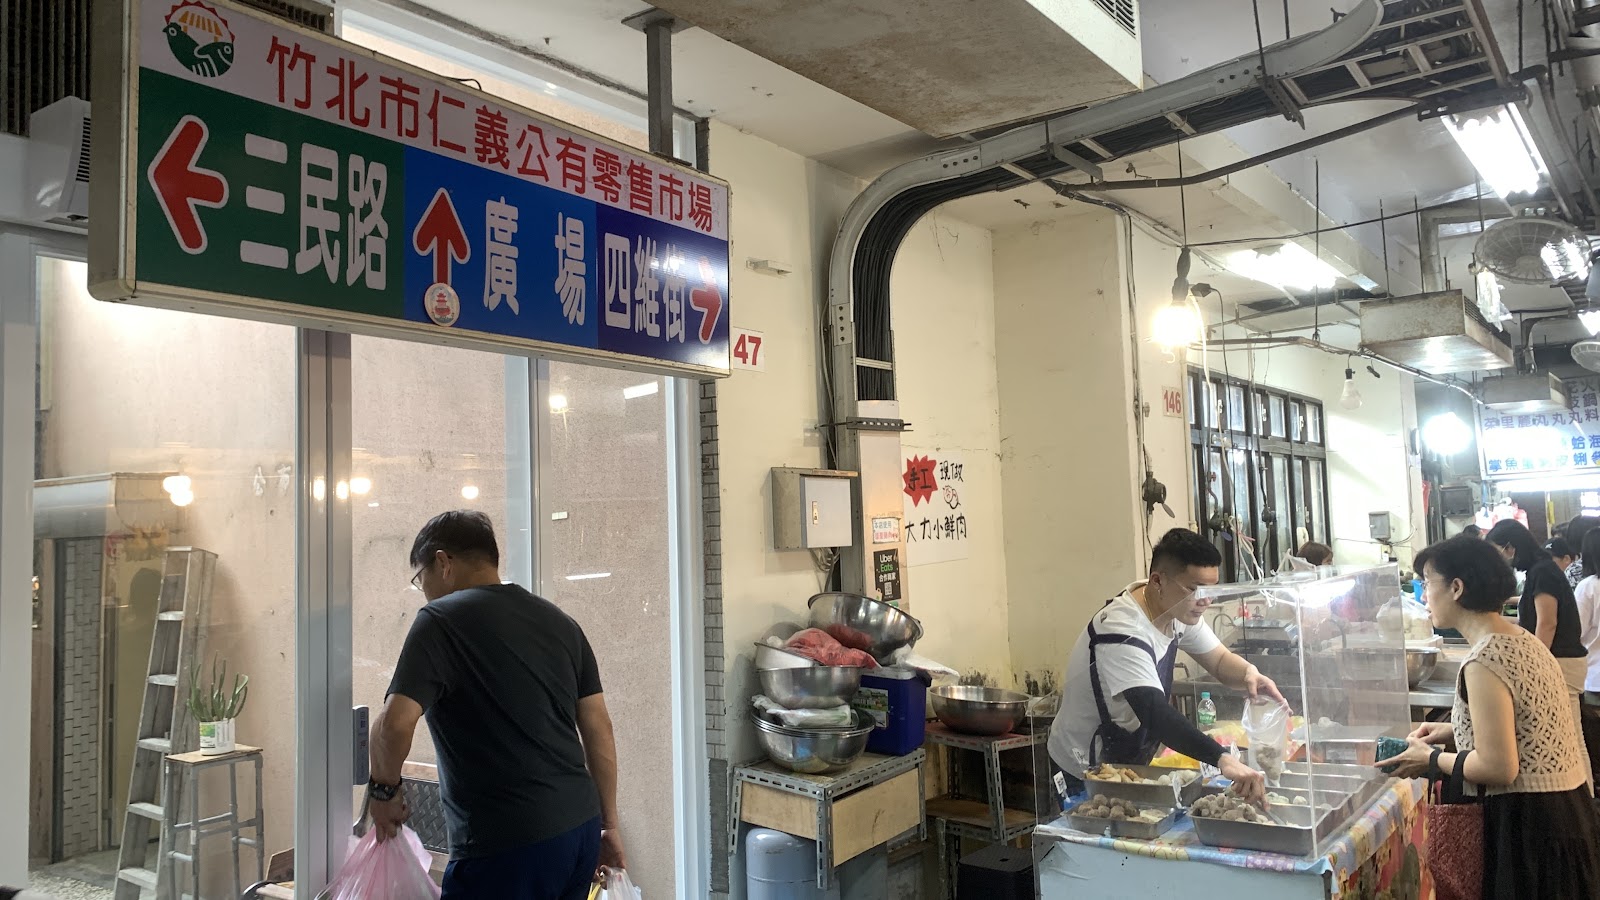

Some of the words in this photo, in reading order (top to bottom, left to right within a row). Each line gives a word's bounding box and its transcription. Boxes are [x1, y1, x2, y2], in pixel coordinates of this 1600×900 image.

[266, 35, 713, 232] 竹北市仁義公有零售市場
[239, 132, 388, 290] 三民路
[483, 196, 585, 326] 廣場
[604, 232, 686, 343] 四維街
[733, 334, 762, 366] 47
[1163, 389, 1182, 414] 146
[908, 465, 933, 492] 手工
[939, 460, 964, 483] 現做
[905, 512, 968, 544] 大力小鮮肉
[879, 554, 893, 563] Uber
[880, 563, 894, 572] Eats
